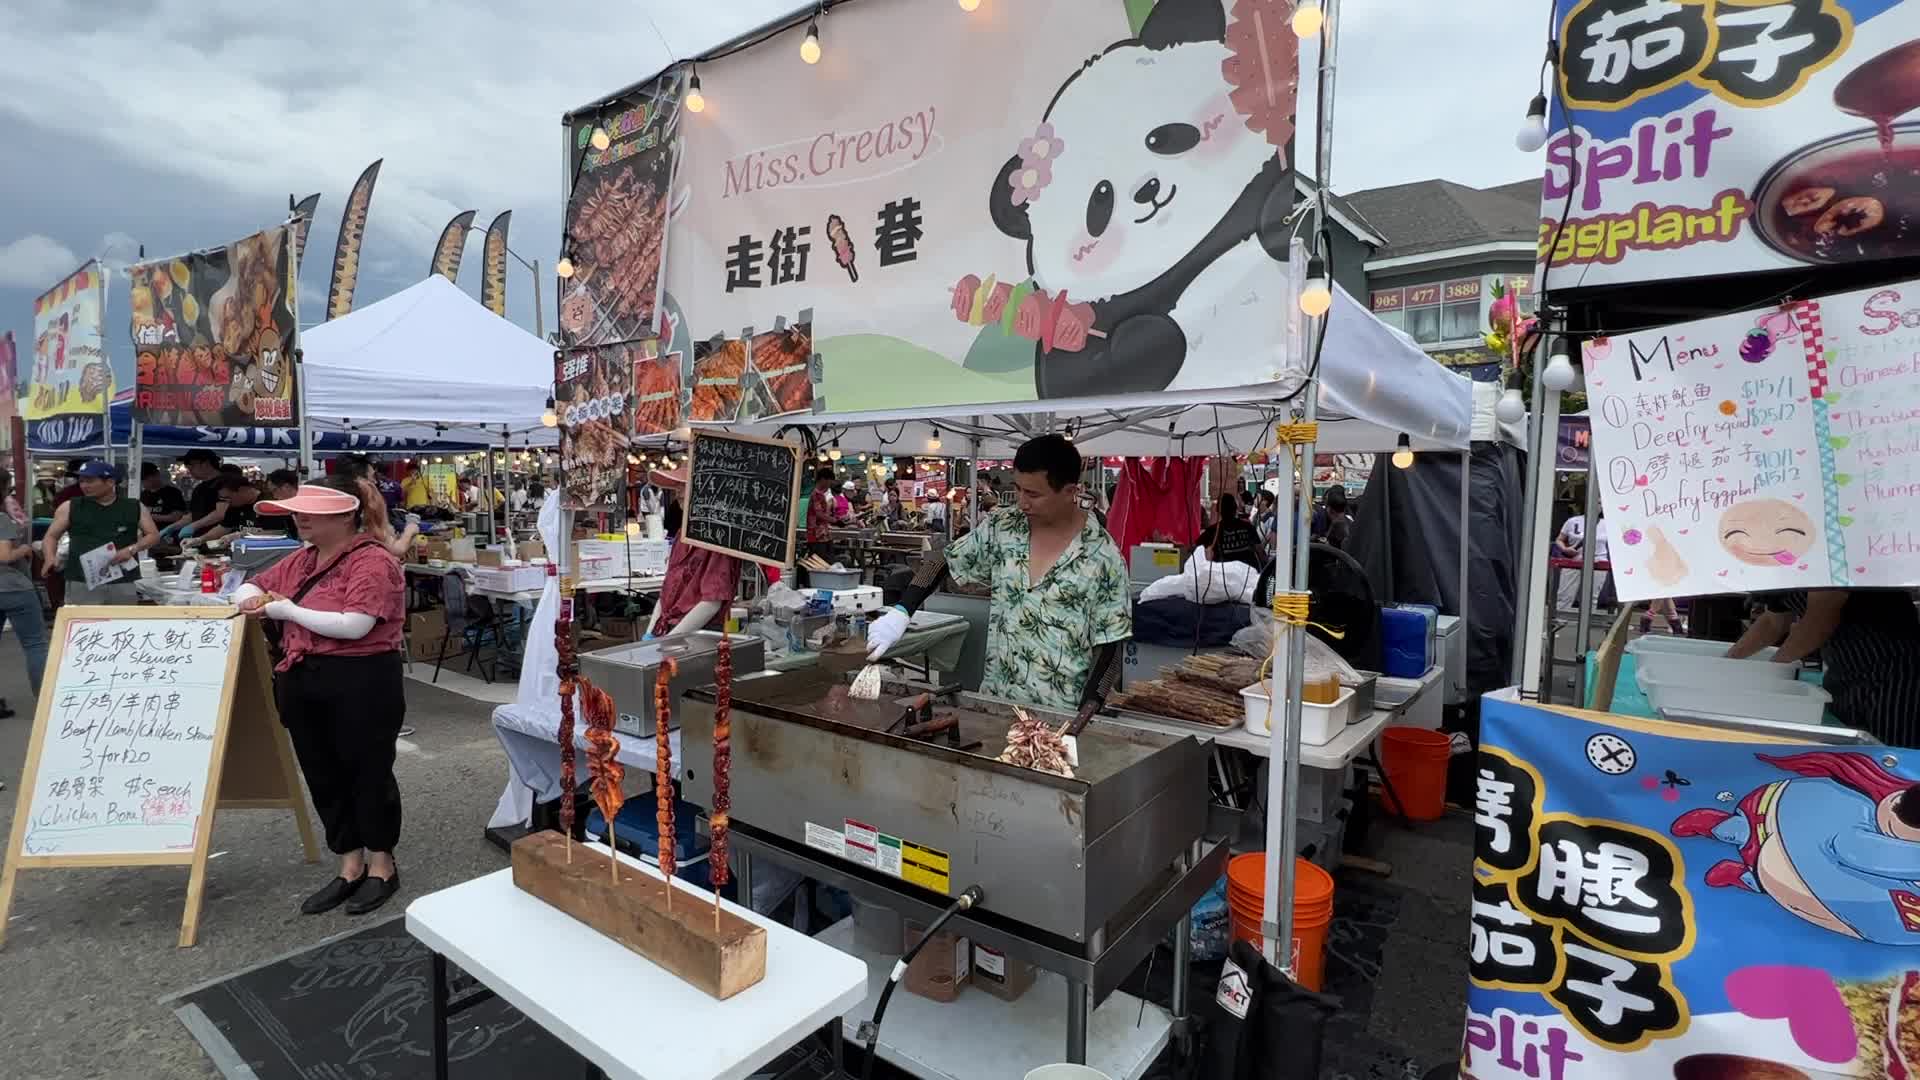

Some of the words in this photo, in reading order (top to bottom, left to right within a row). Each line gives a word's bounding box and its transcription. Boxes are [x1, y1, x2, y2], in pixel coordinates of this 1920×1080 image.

[1580, 0, 1815, 83] 茄子
[723, 106, 937, 199] Miss.Greasy
[1543, 110, 1733, 210] Split
[725, 225, 811, 293] 走街
[874, 197, 924, 267] 巷
[1539, 196, 1745, 261] Eggplant
[1376, 295, 1398, 307] 905
[1411, 289, 1434, 302] 477
[1446, 283, 1479, 298] 3880
[1509, 275, 1528, 297] 中
[1628, 336, 1719, 381] Menu
[84, 671, 100, 684] 2
[110, 666, 139, 692] for
